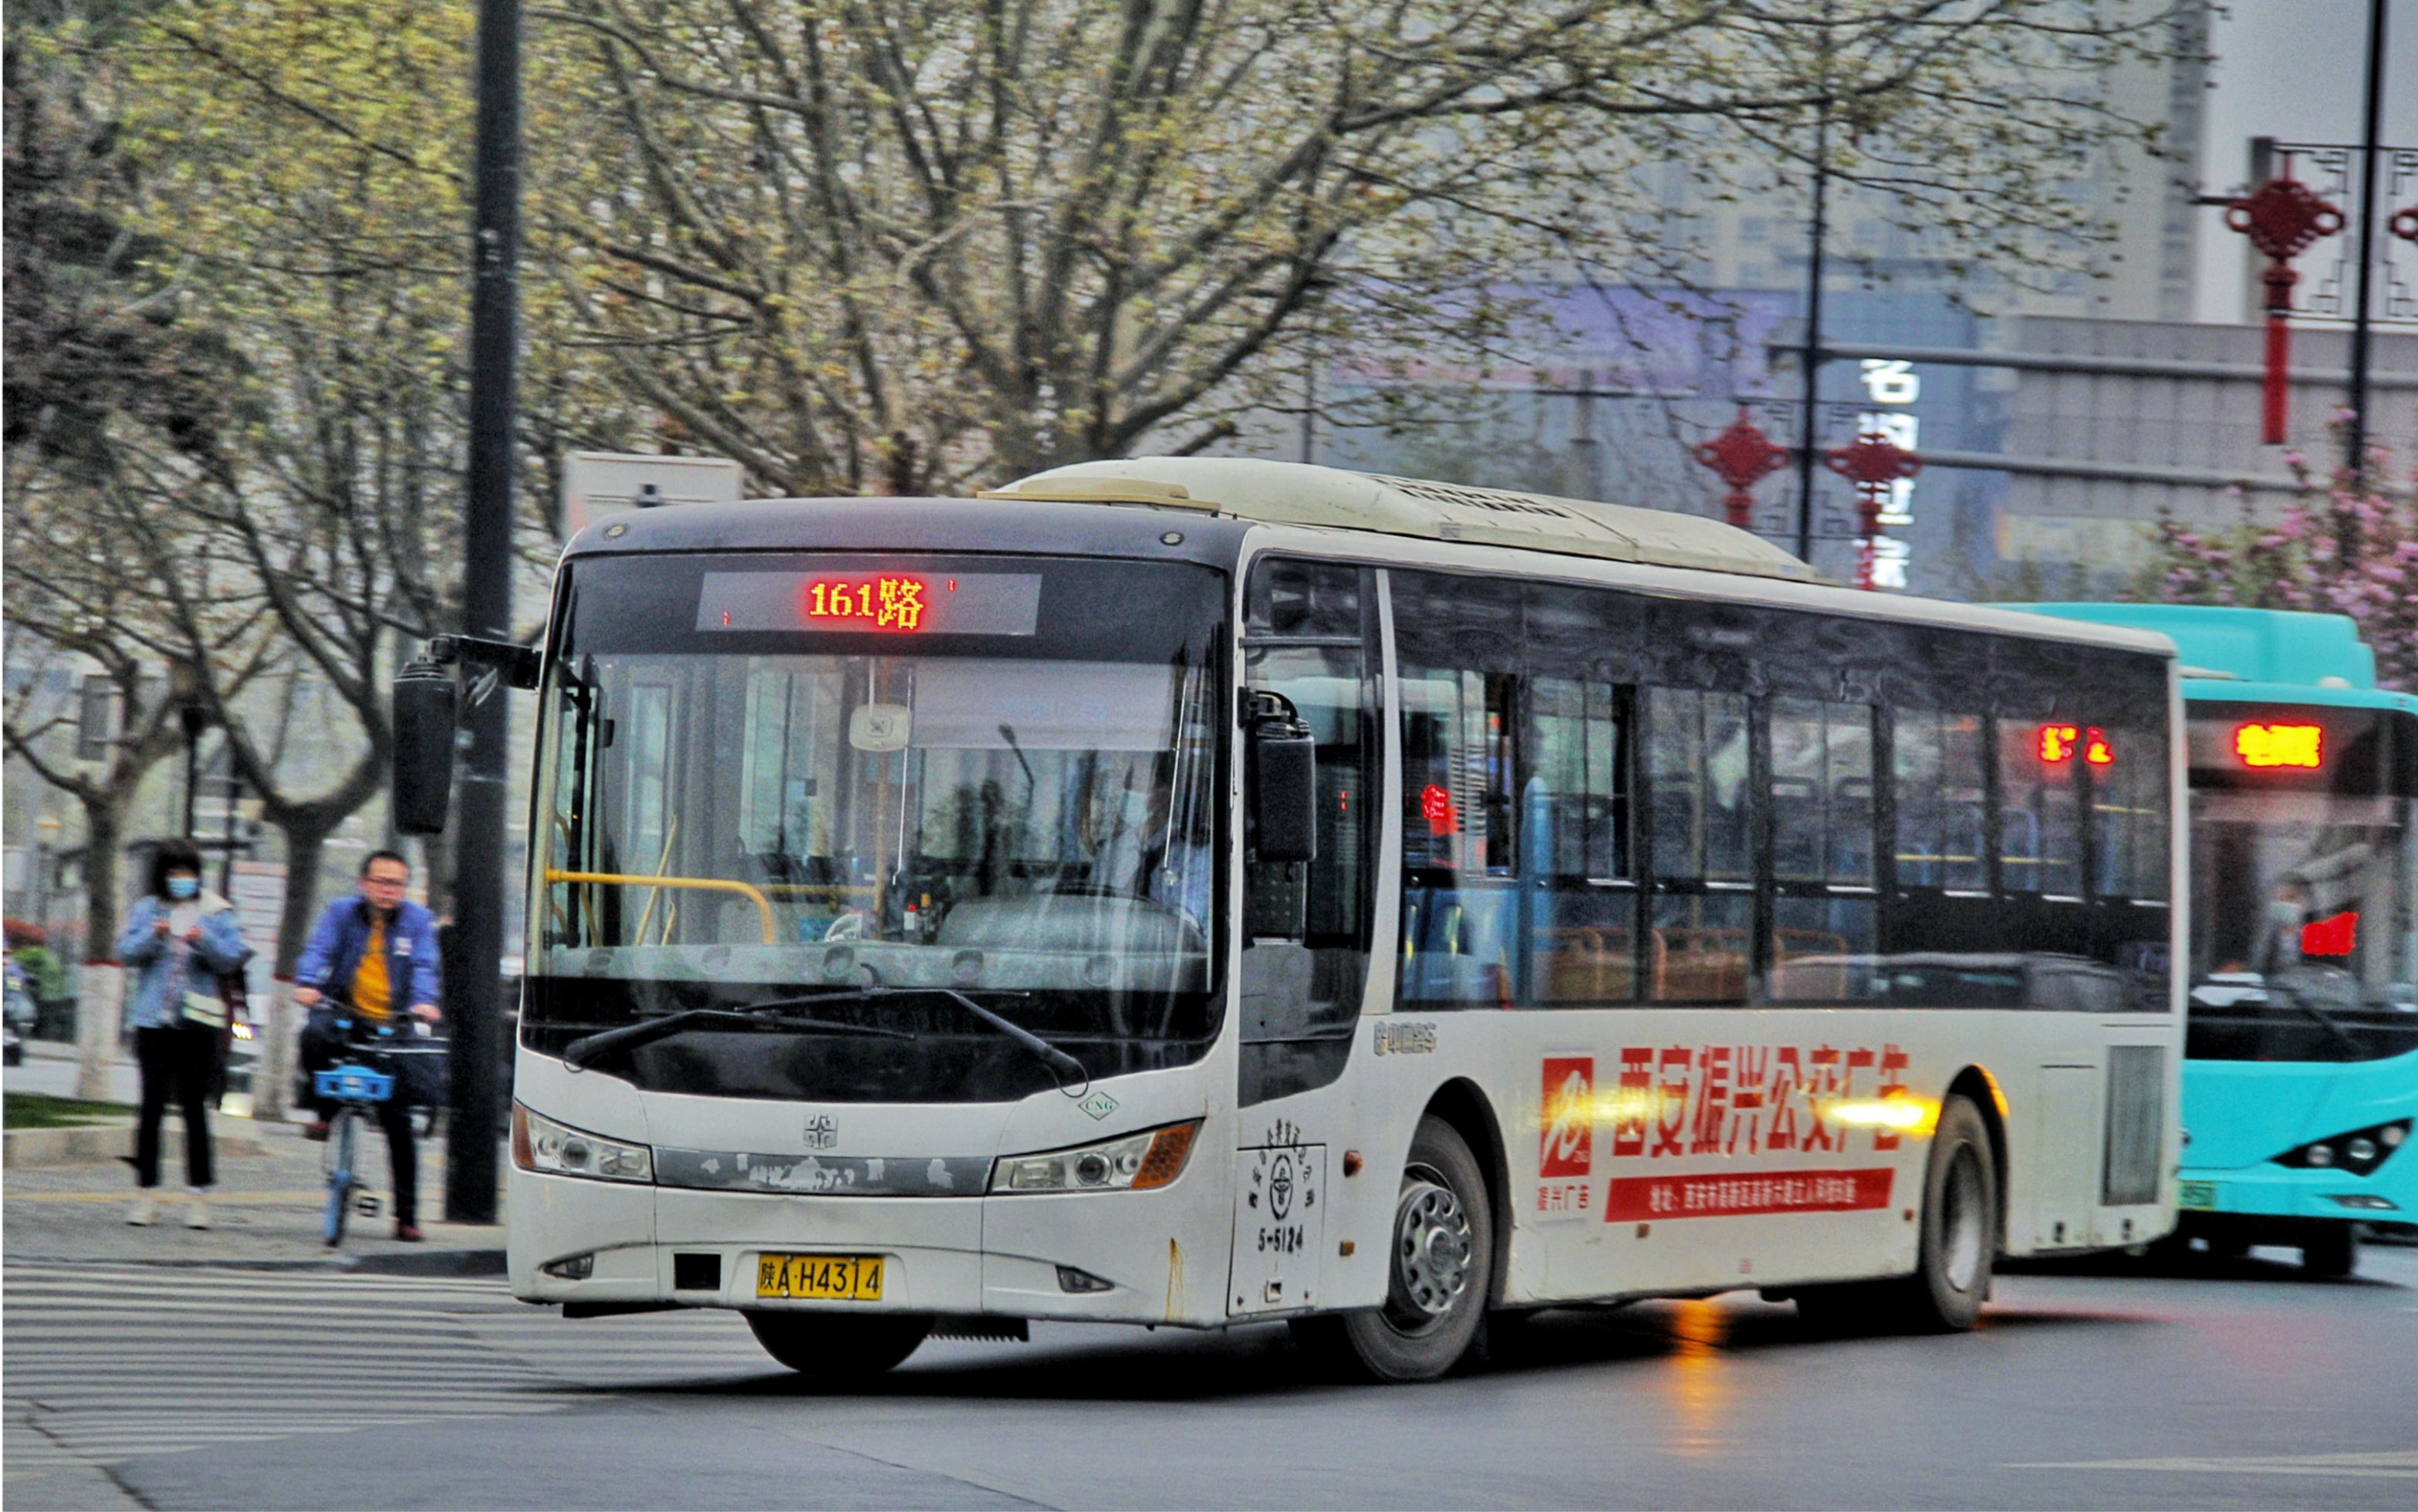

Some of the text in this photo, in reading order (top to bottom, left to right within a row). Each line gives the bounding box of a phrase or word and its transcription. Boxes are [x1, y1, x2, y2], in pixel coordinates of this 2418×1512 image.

[809, 578, 924, 629] 161路
[1085, 1100, 1114, 1111] CNG
[1612, 1044, 1910, 1158] 西安振兴公交广告
